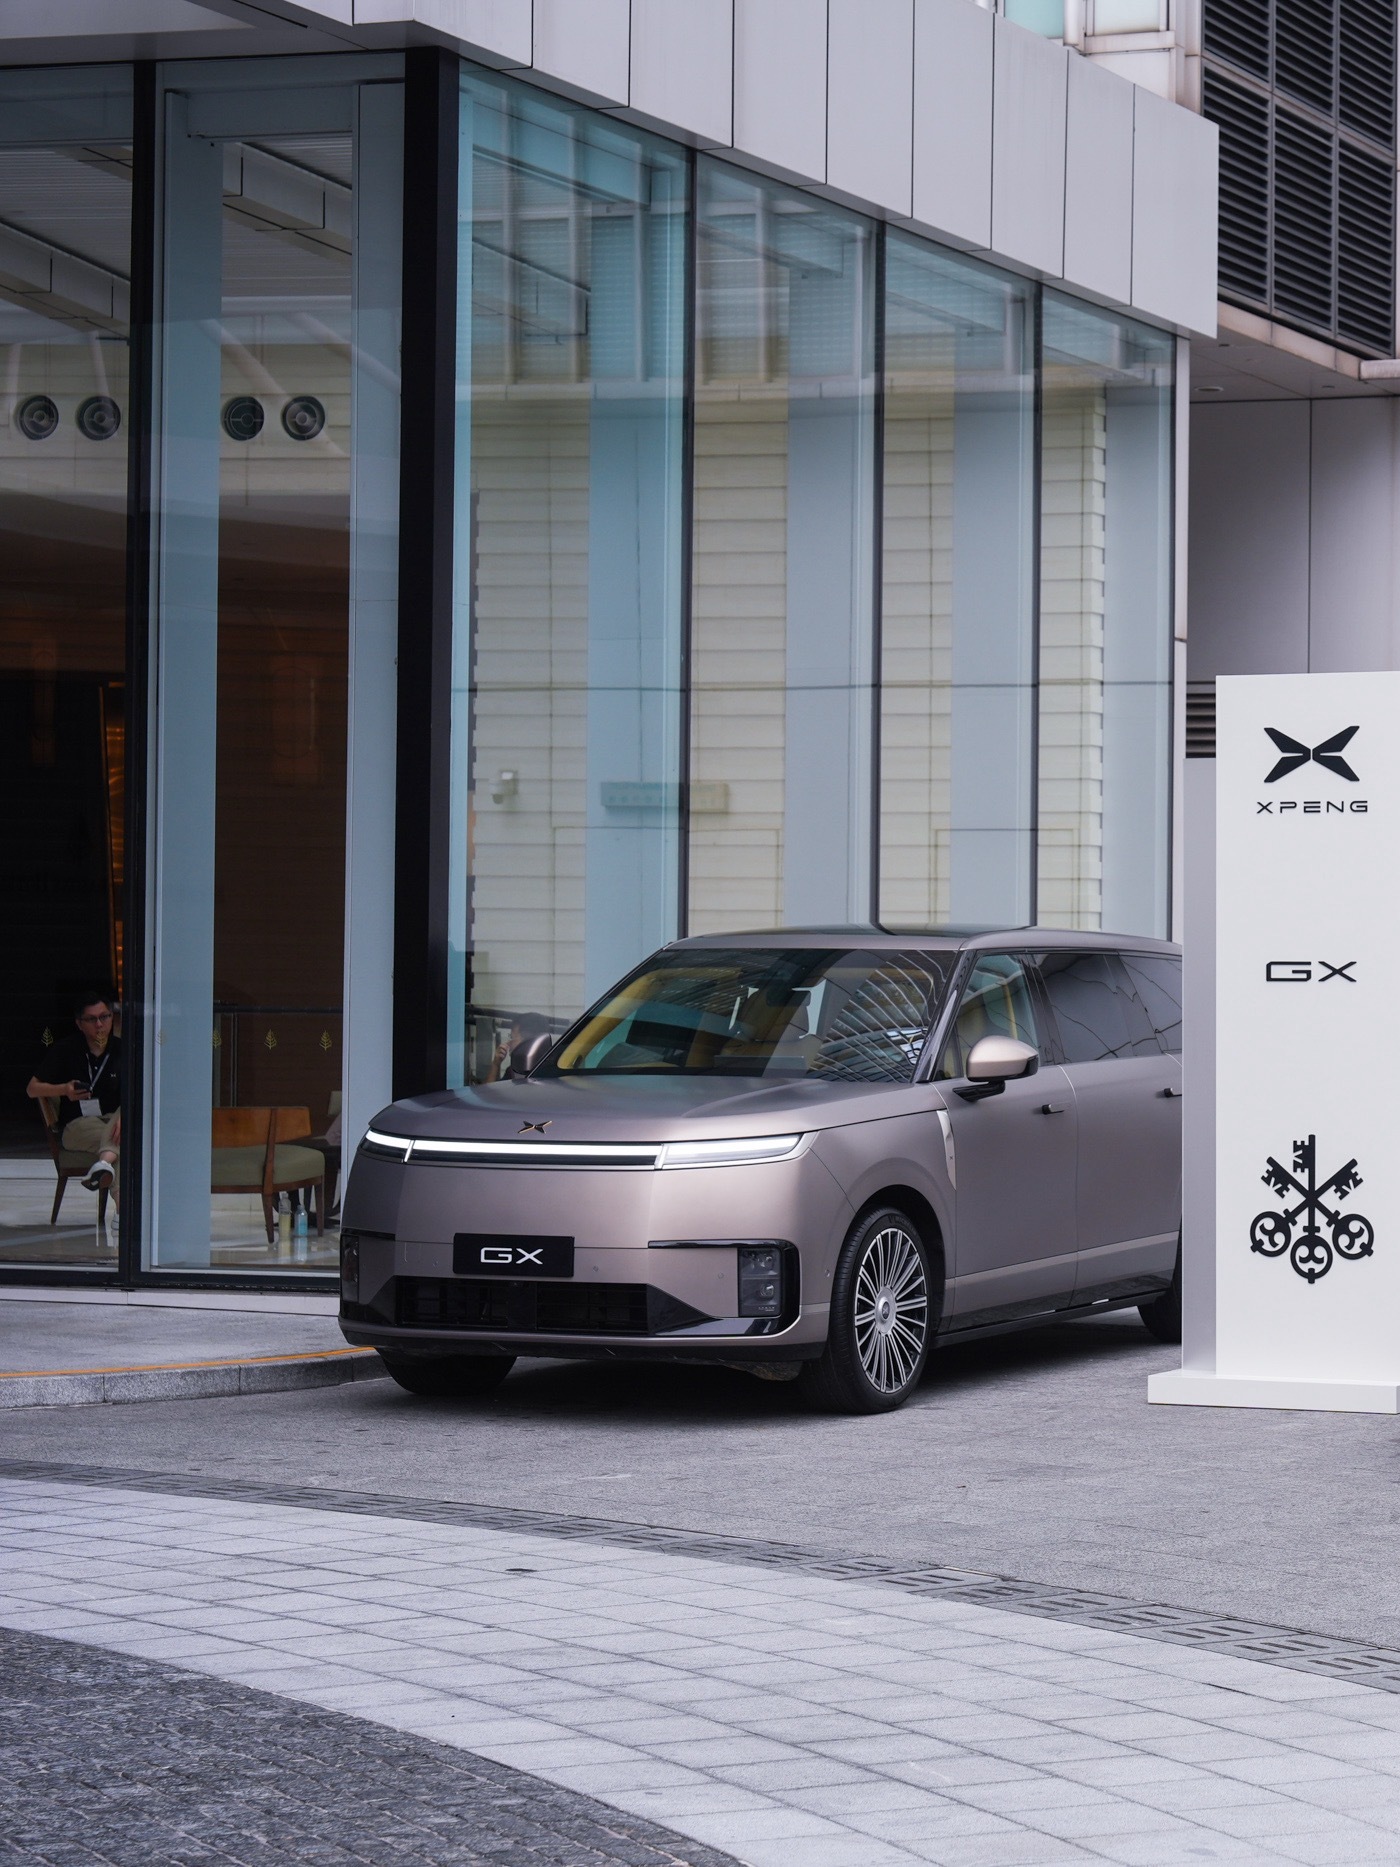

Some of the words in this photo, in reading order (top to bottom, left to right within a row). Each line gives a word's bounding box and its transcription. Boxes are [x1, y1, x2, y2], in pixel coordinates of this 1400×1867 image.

[1256, 800, 1368, 814] XPENG
[1265, 960, 1358, 983] GX
[480, 1247, 544, 1265] GX
